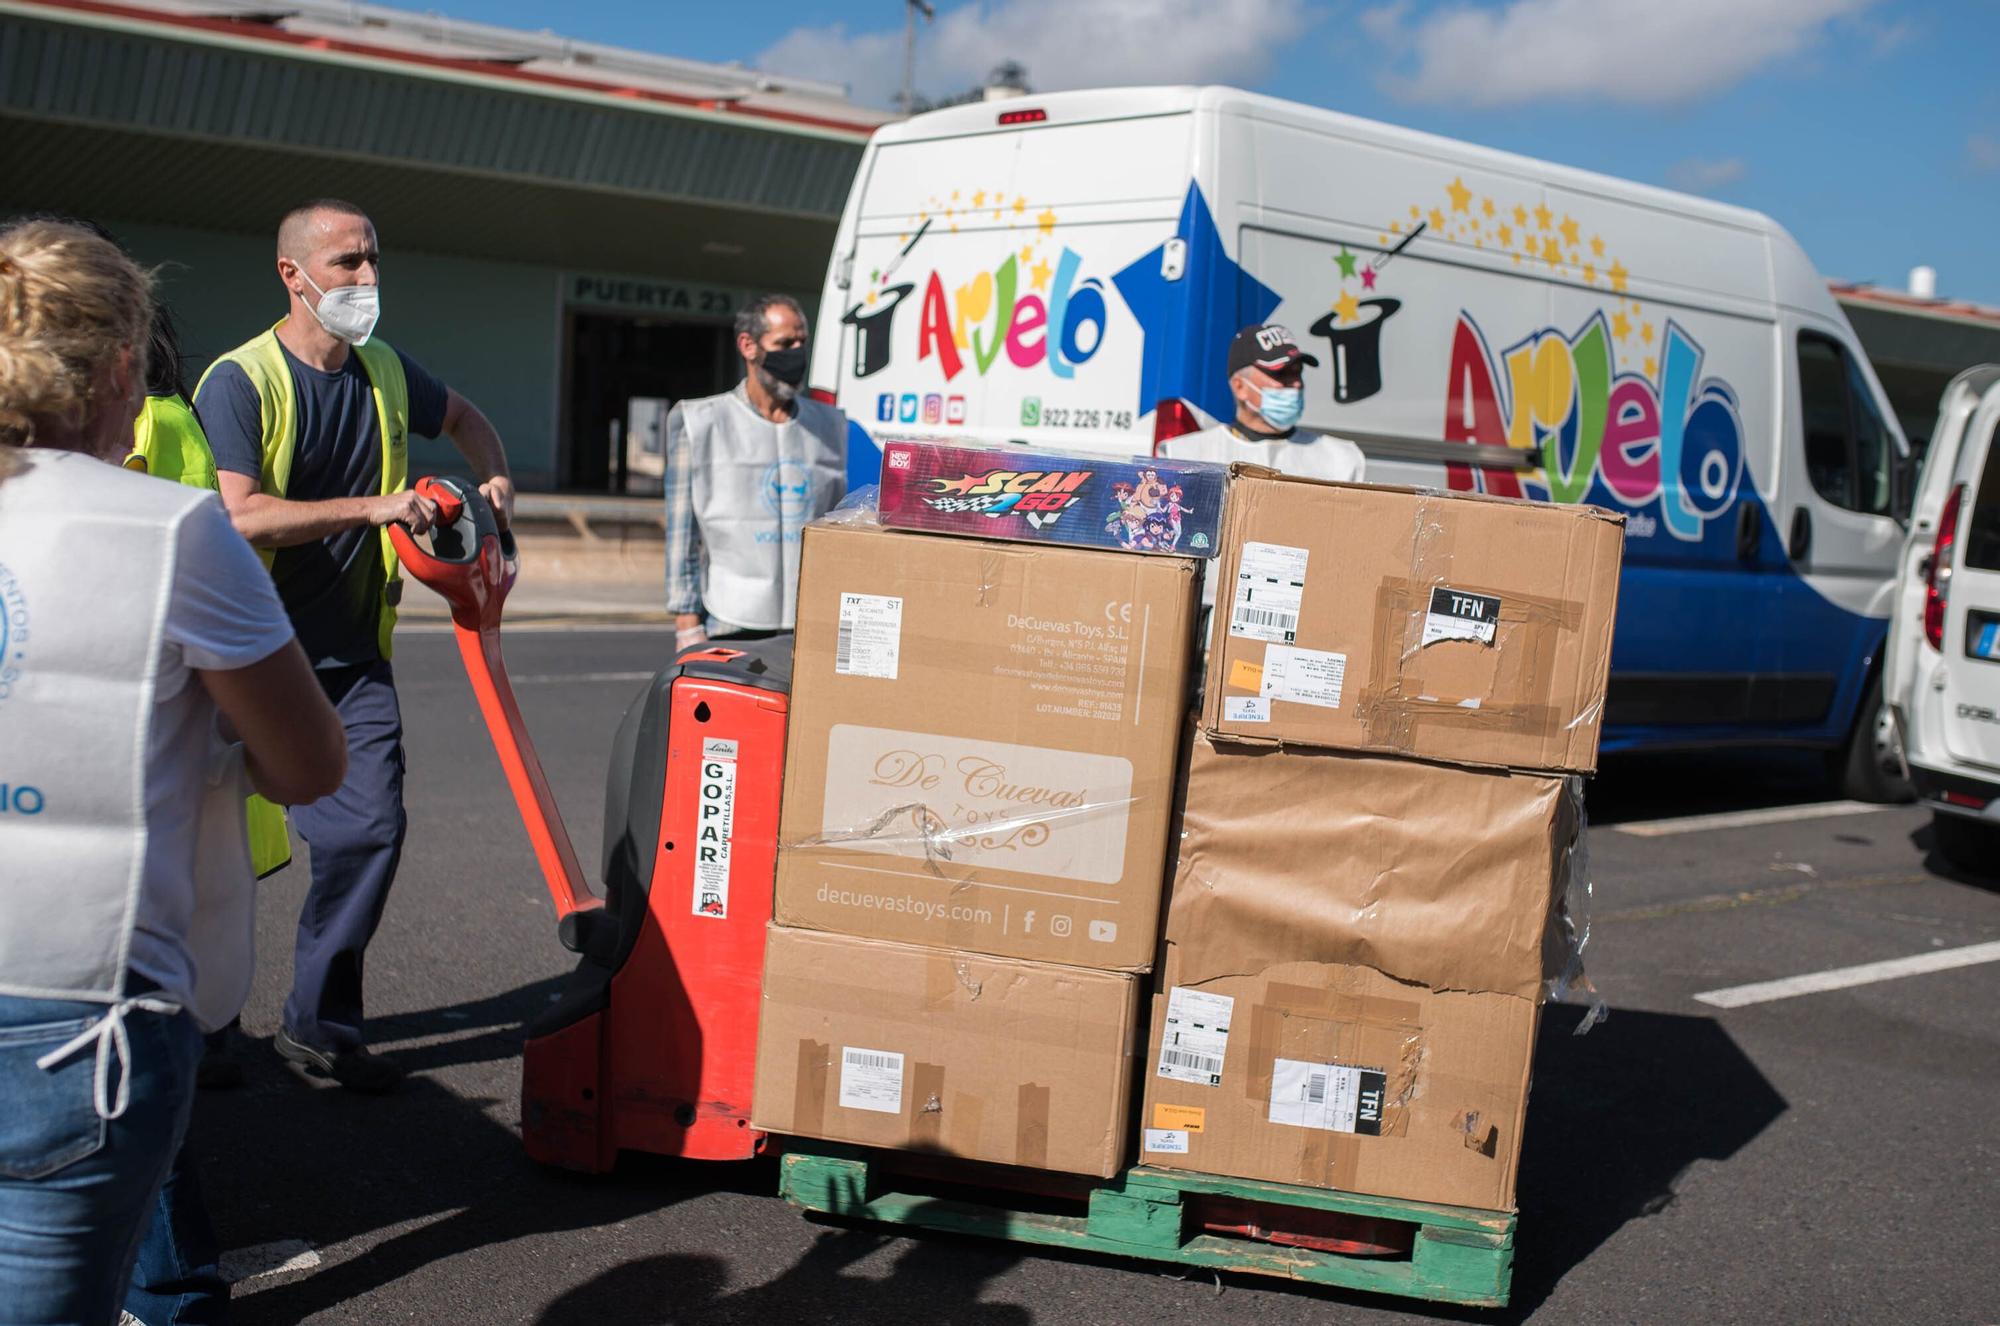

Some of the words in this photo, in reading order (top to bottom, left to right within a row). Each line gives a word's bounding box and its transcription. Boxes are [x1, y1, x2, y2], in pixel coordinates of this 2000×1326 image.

[575, 277, 690, 310] PUERTA
[702, 292, 731, 313] 23
[1043, 408, 1068, 427] 922
[1072, 409, 1100, 428] 226
[1105, 411, 1132, 430] 748
[890, 459, 909, 469] BOY
[891, 451, 910, 461] NEW
[968, 471, 1094, 494] SCAN
[983, 493, 1022, 513] 2
[887, 600, 900, 610] ST
[1452, 596, 1484, 618] TFN
[1007, 614, 1071, 634] DeCuevas
[1073, 621, 1104, 639] Toys,
[1107, 625, 1129, 640] S.L.
[1233, 712, 1265, 721] TENERIFE
[868, 749, 946, 790] De
[956, 756, 1088, 807] Cuevas
[817, 883, 992, 925] decuevastoys.com
[1359, 1090, 1380, 1121] TFN
